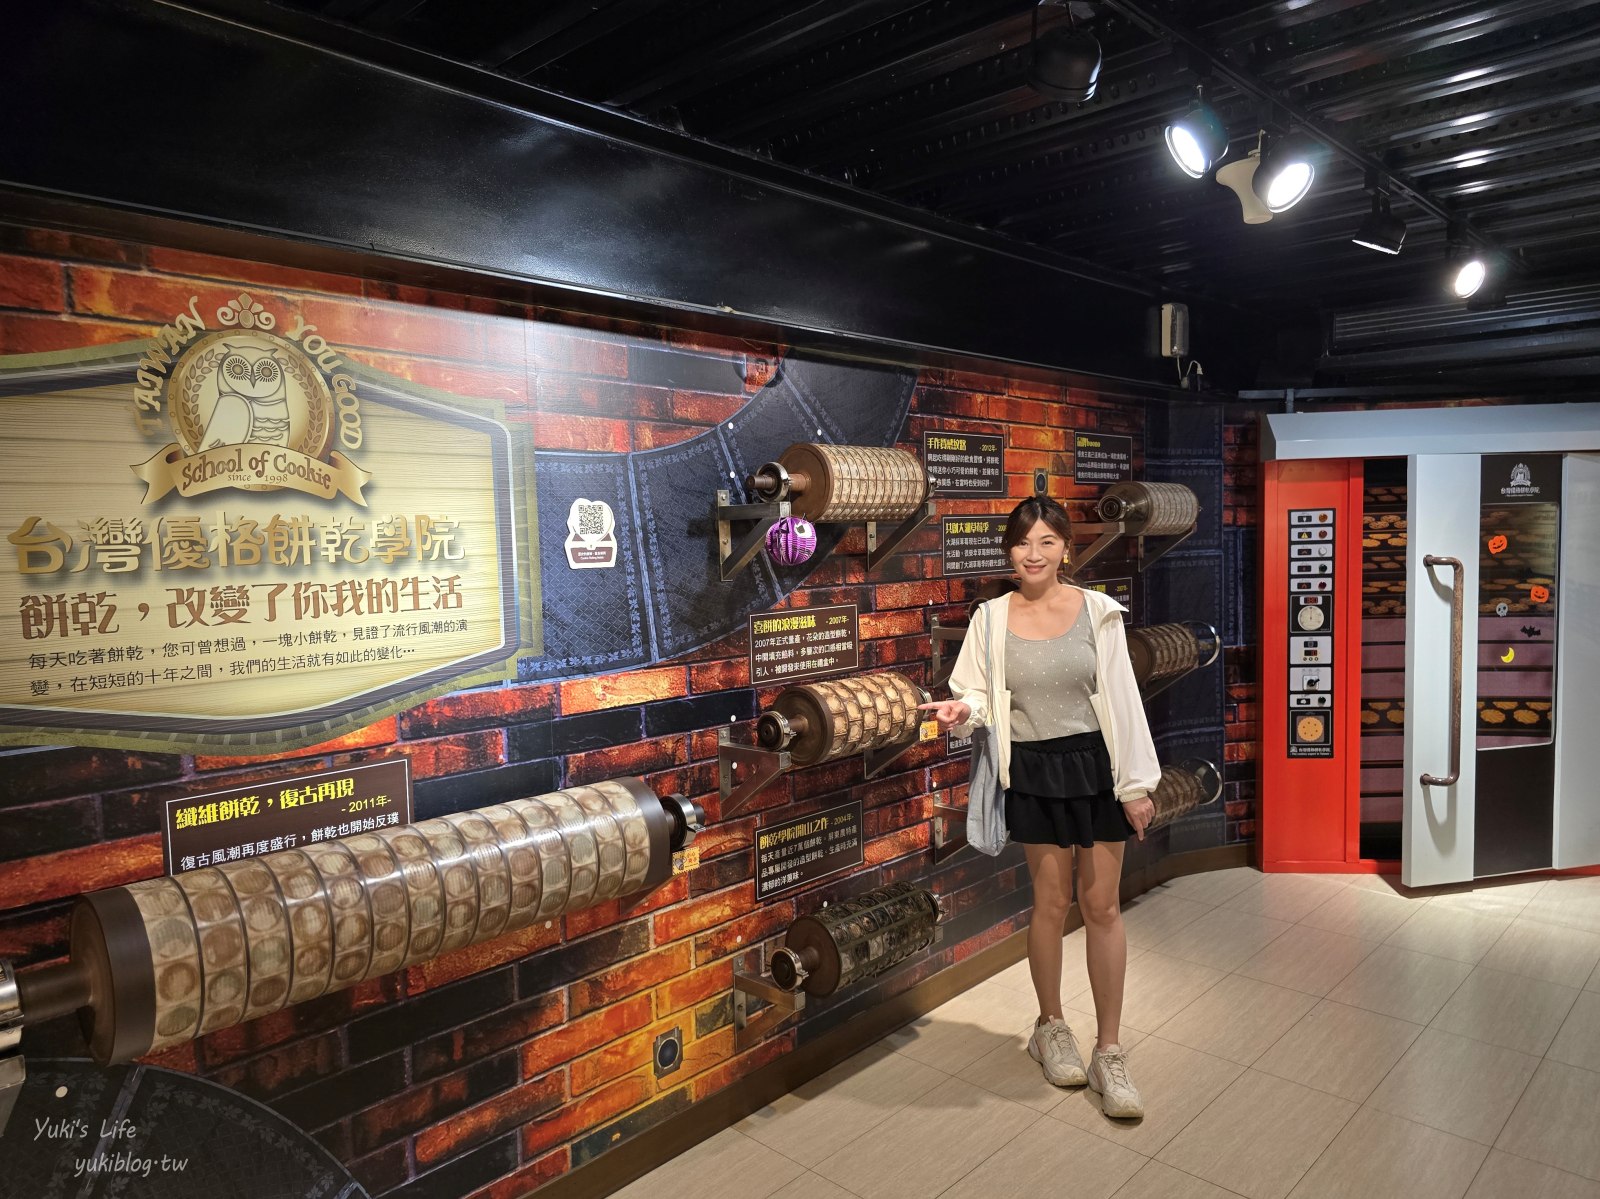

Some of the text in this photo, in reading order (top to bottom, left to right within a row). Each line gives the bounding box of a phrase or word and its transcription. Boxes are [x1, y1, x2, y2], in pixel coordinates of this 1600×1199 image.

[133, 296, 363, 449] TAIWAN YOU GOOD
[182, 449, 331, 490] School of Cookie
[227, 473, 288, 484] since 1998
[7, 511, 466, 575] 台灣優格餅乾學院
[20, 574, 463, 641] 餅乾，改變了你我的生活
[29, 619, 468, 670] 每天吃著餅乾，您可曾想過，一塊小餅乾，見證了流行風潮的演
[176, 778, 355, 831] 纖維餅乾，復古再現
[180, 811, 400, 871] 復古風潮再度盛行，餅乾也開始反璞
